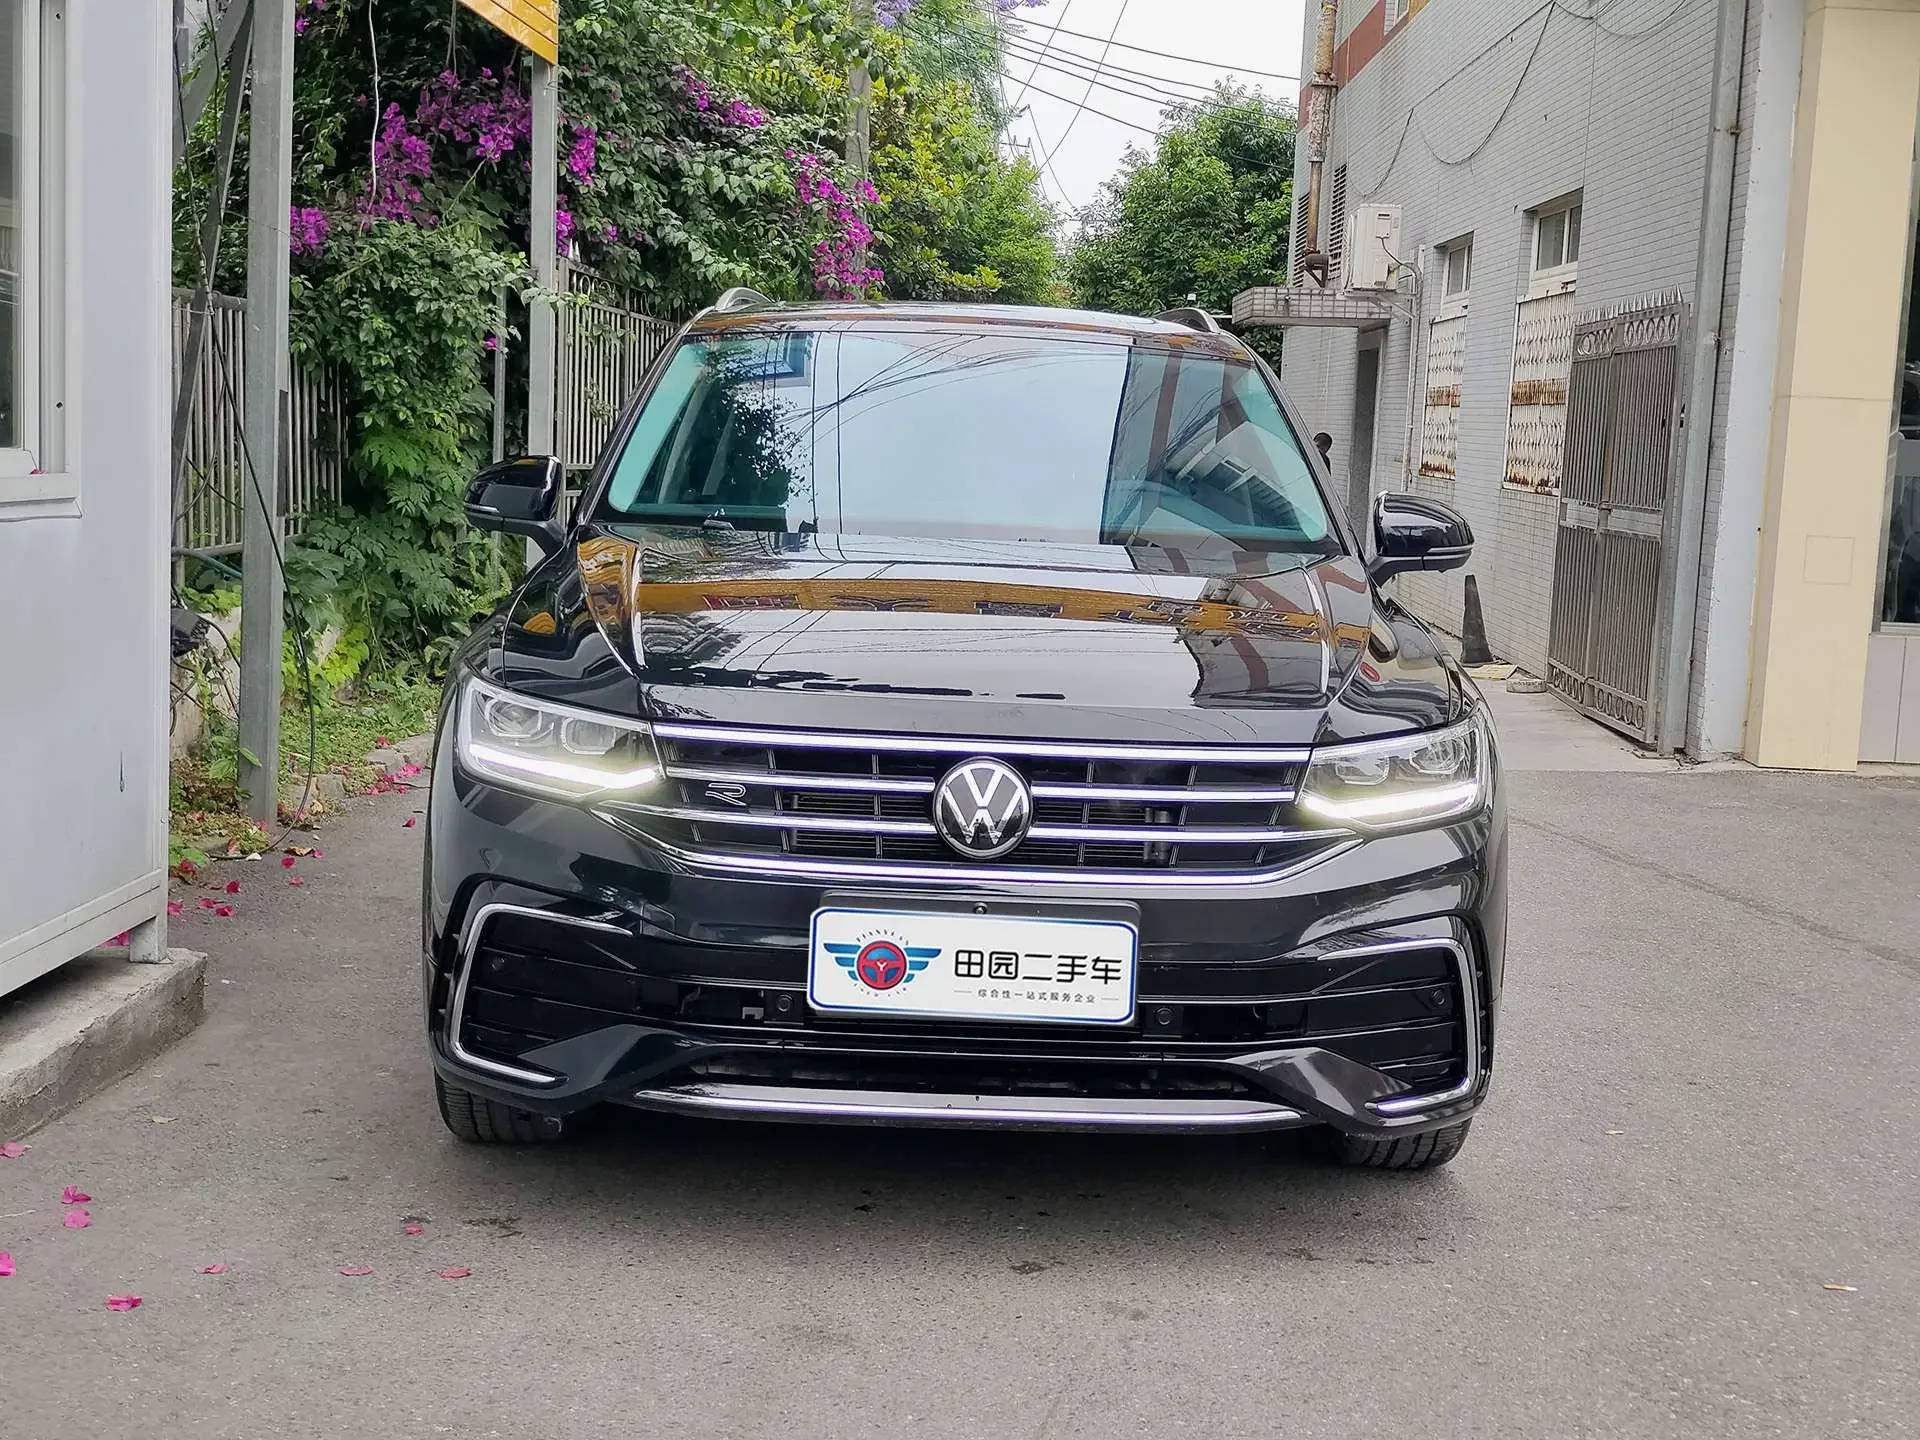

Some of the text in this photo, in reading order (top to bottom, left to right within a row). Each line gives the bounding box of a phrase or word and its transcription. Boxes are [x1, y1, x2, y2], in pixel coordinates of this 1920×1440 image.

[954, 949, 1122, 985] 田园二手车
[978, 988, 1096, 1003] 综合性一站式服务企业
